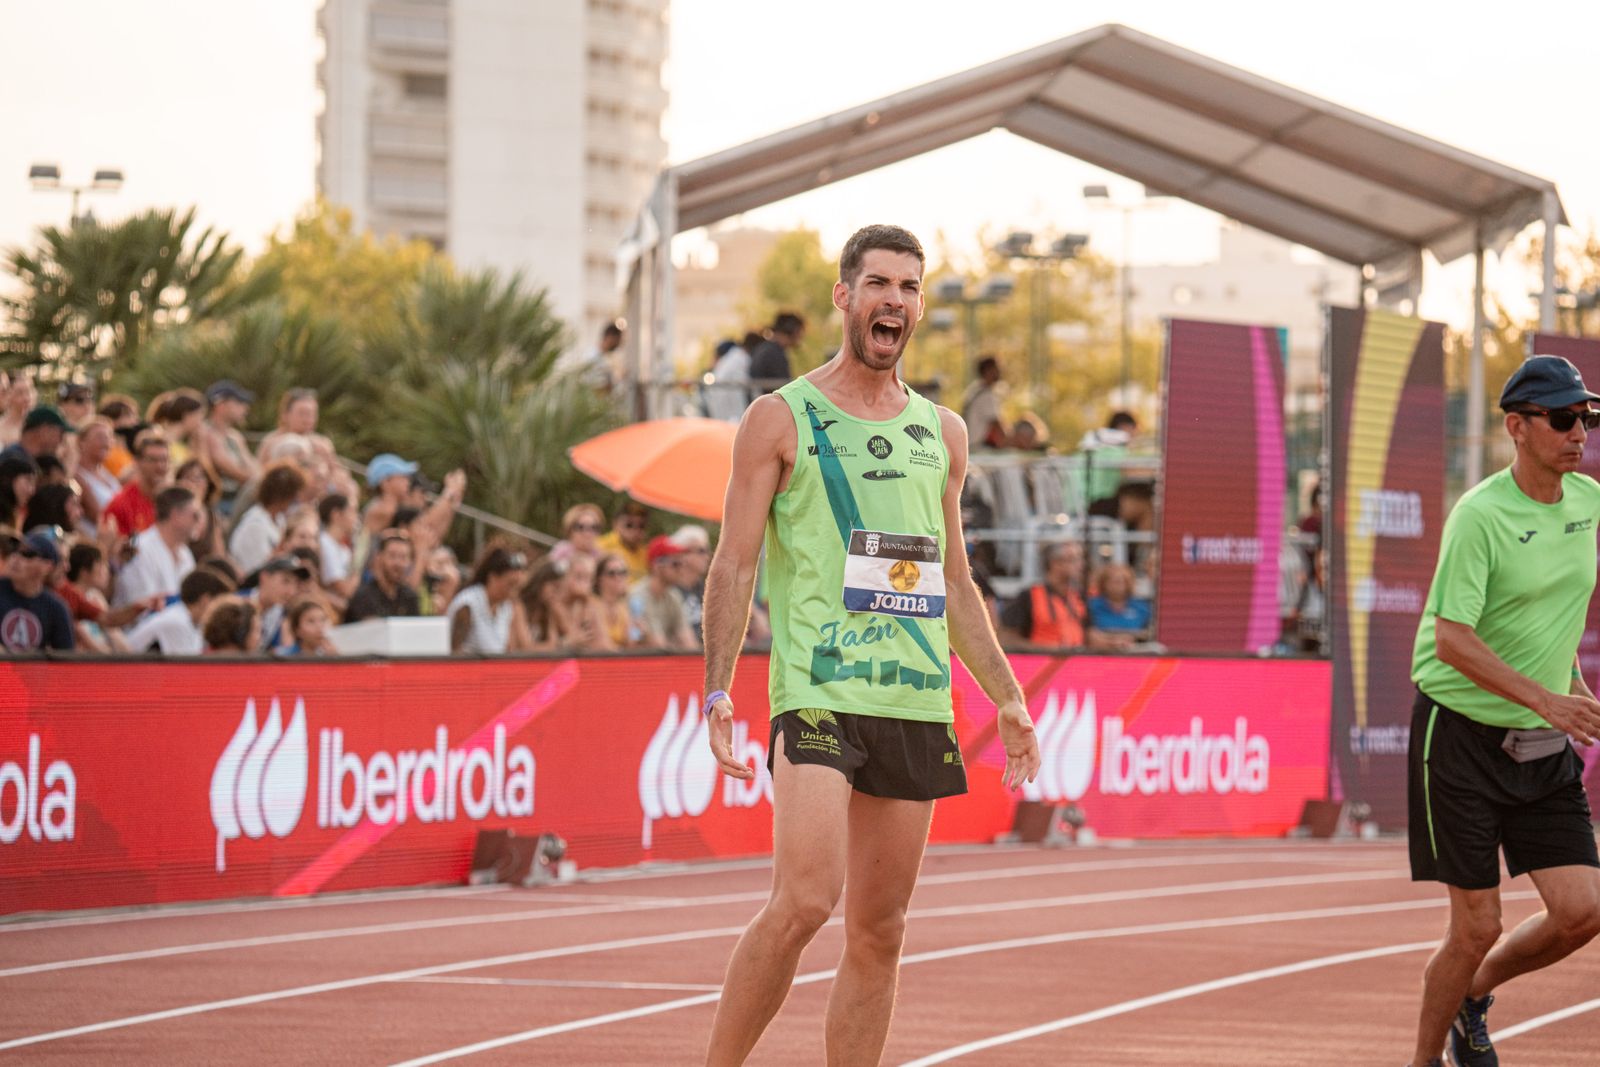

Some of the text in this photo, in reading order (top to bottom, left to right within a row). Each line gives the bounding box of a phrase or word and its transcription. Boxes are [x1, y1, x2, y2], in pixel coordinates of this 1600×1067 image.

[820, 443, 848, 455] Jaén
[910, 449, 940, 462] Unicaja
[819, 616, 899, 649] Jaén
[801, 730, 839, 745] Unicaja
[796, 744, 828, 752] Fundación
[1099, 716, 1270, 796] Iberdrola
[317, 723, 536, 829] Iberdrola
